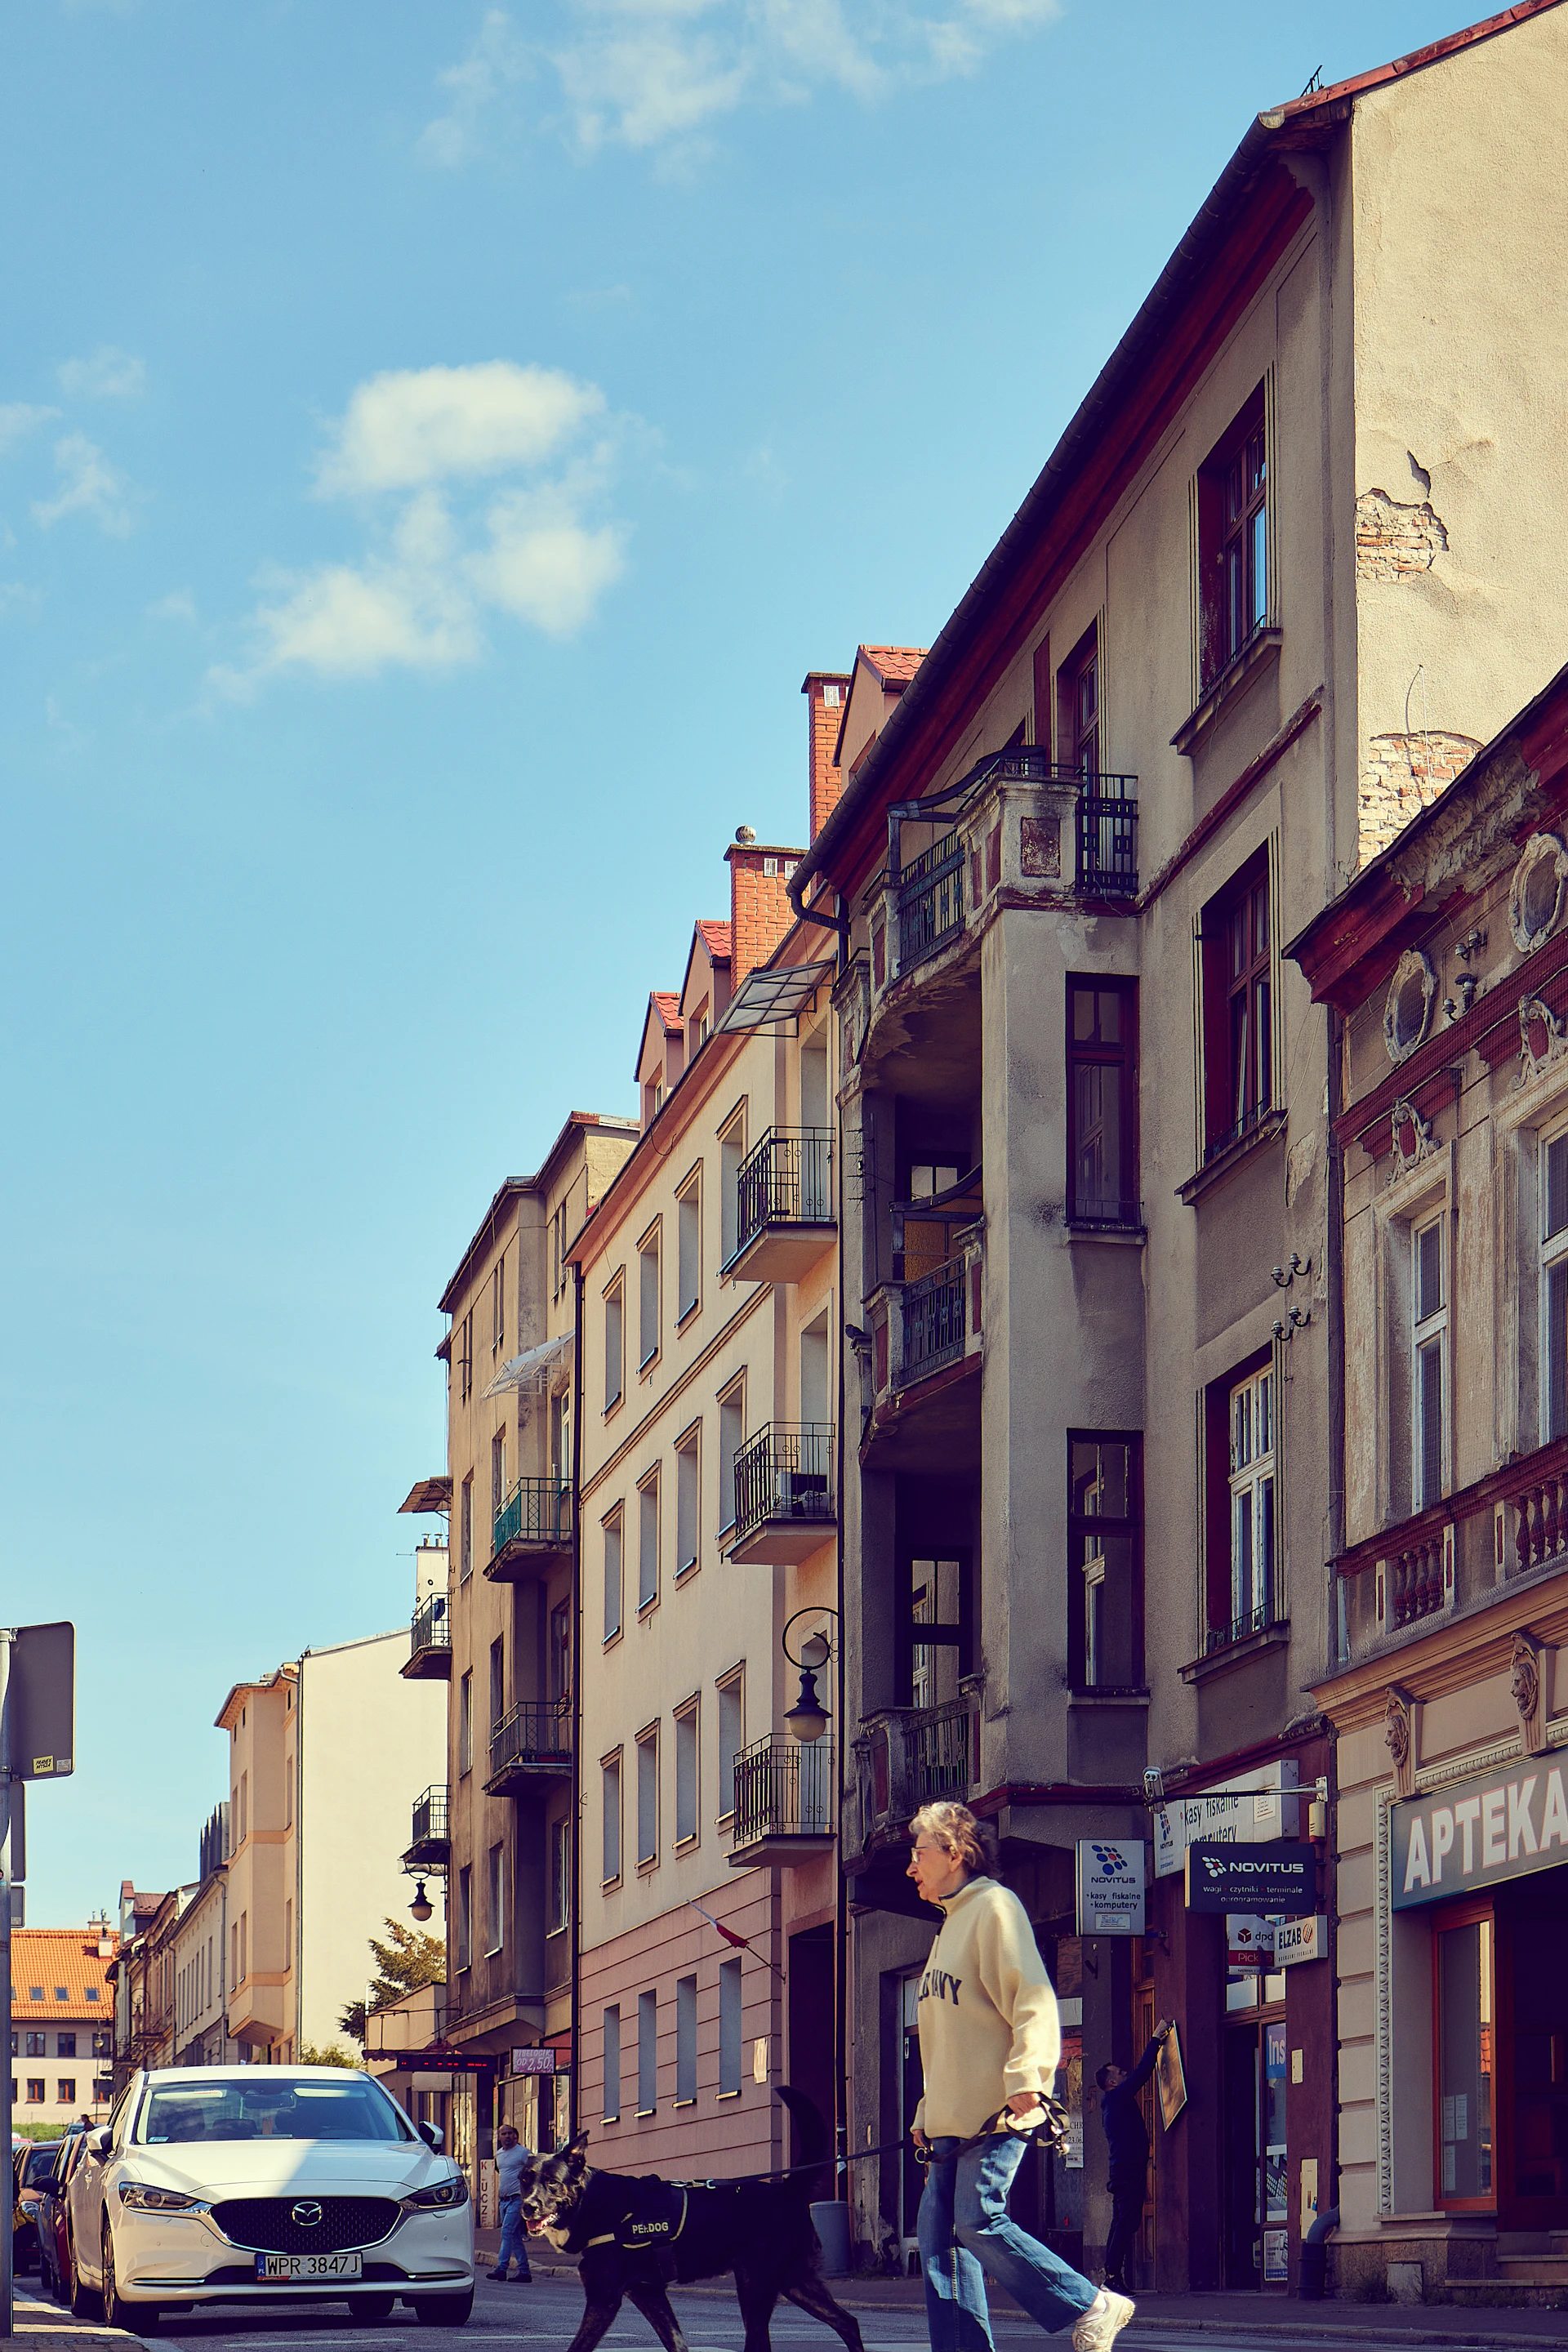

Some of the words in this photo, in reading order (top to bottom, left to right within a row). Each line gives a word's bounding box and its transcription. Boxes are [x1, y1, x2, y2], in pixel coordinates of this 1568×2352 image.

[1184, 1802, 1202, 1828] kasy
[1206, 1788, 1239, 1819] fiskalne
[1189, 1824, 1237, 1842] utery
[1403, 1767, 1568, 1894] APTEKA
[1229, 1862, 1304, 1873] NOVITUS
[1090, 1891, 1107, 1900] kasy
[1203, 1885, 1222, 1894] wagi
[1229, 1885, 1258, 1894] czytniki
[1267, 1886, 1303, 1894] terminale
[1094, 1900, 1138, 1910] komputery
[1255, 1931, 1273, 1943] dpd
[1278, 1927, 1302, 1950] ELZAB
[1238, 1953, 1273, 1962] Pick
[1268, 2034, 1285, 2066] Ins
[516, 2058, 528, 2066] OD
[480, 2161, 488, 2227] KUCZE
[267, 2257, 301, 2275] WPR
[307, 2256, 358, 2274] 3847J
